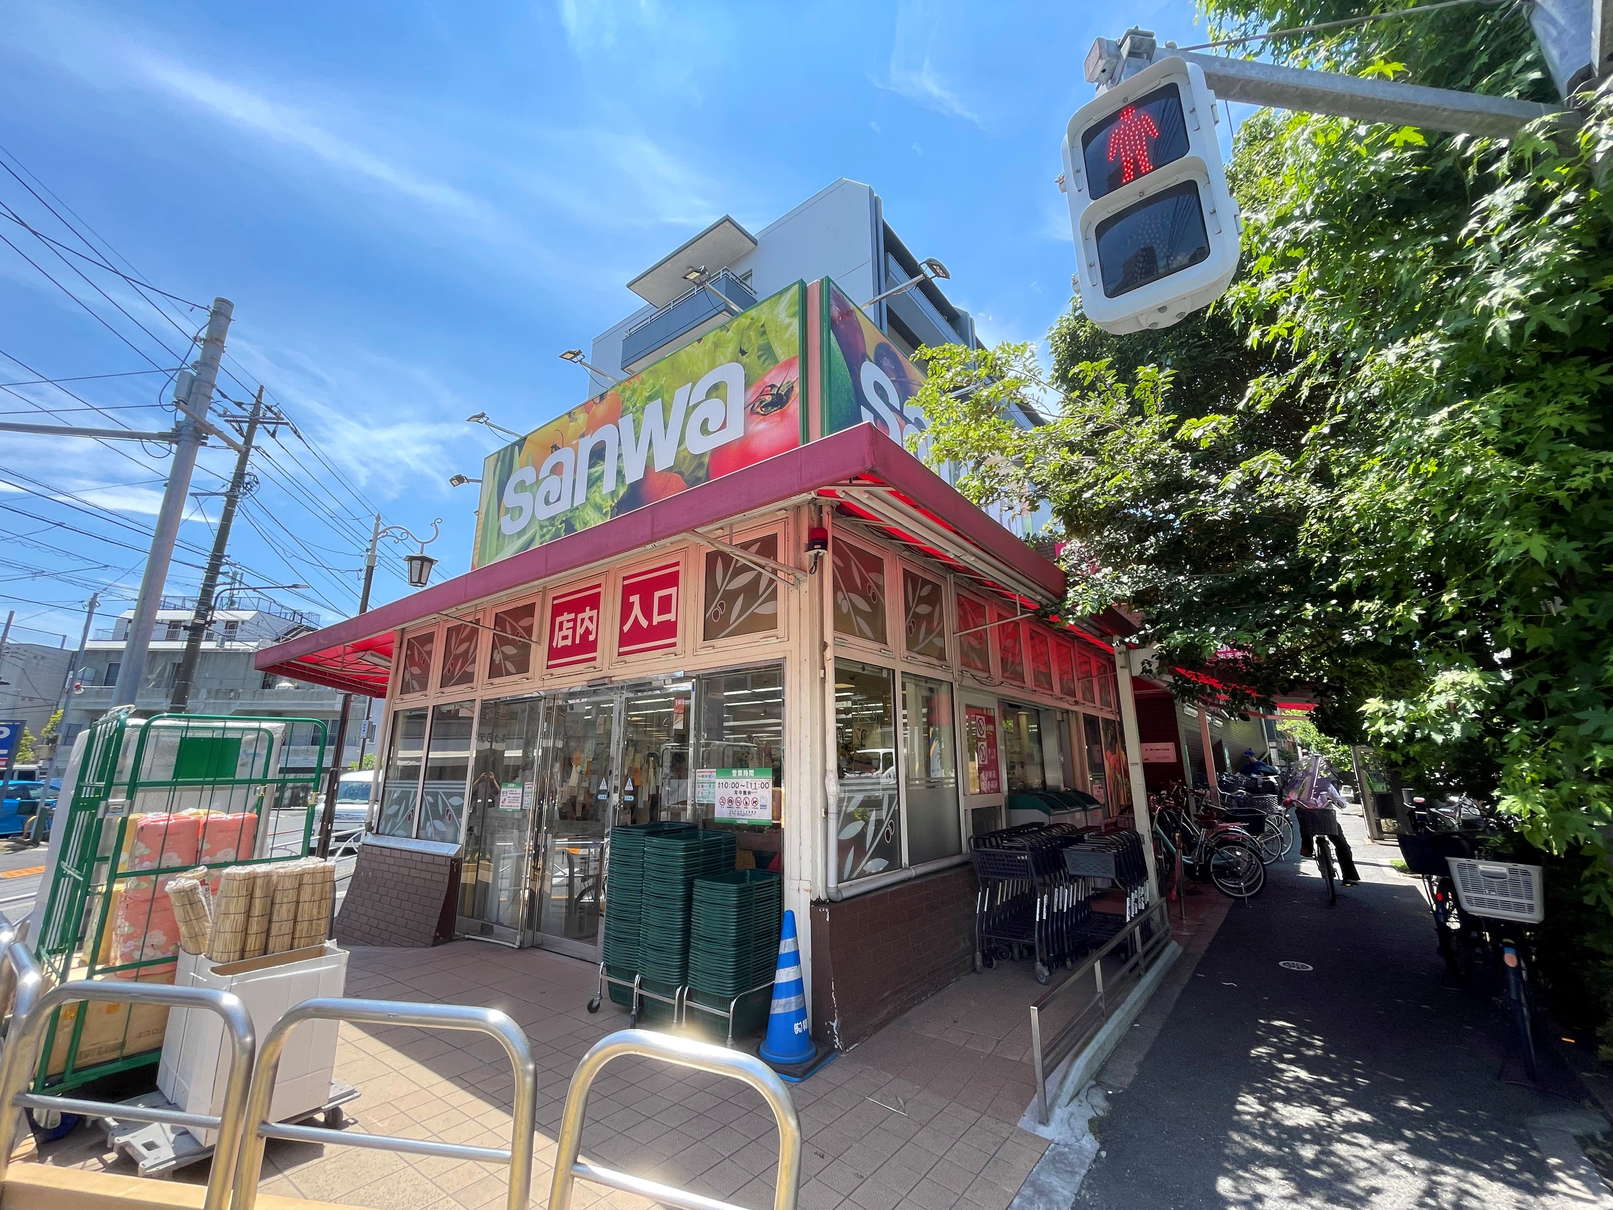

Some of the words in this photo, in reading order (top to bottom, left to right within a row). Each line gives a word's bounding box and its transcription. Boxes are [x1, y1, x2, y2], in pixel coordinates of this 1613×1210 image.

[500, 362, 746, 536] sanwa
[552, 606, 598, 649] 店内
[622, 586, 678, 633] 入口
